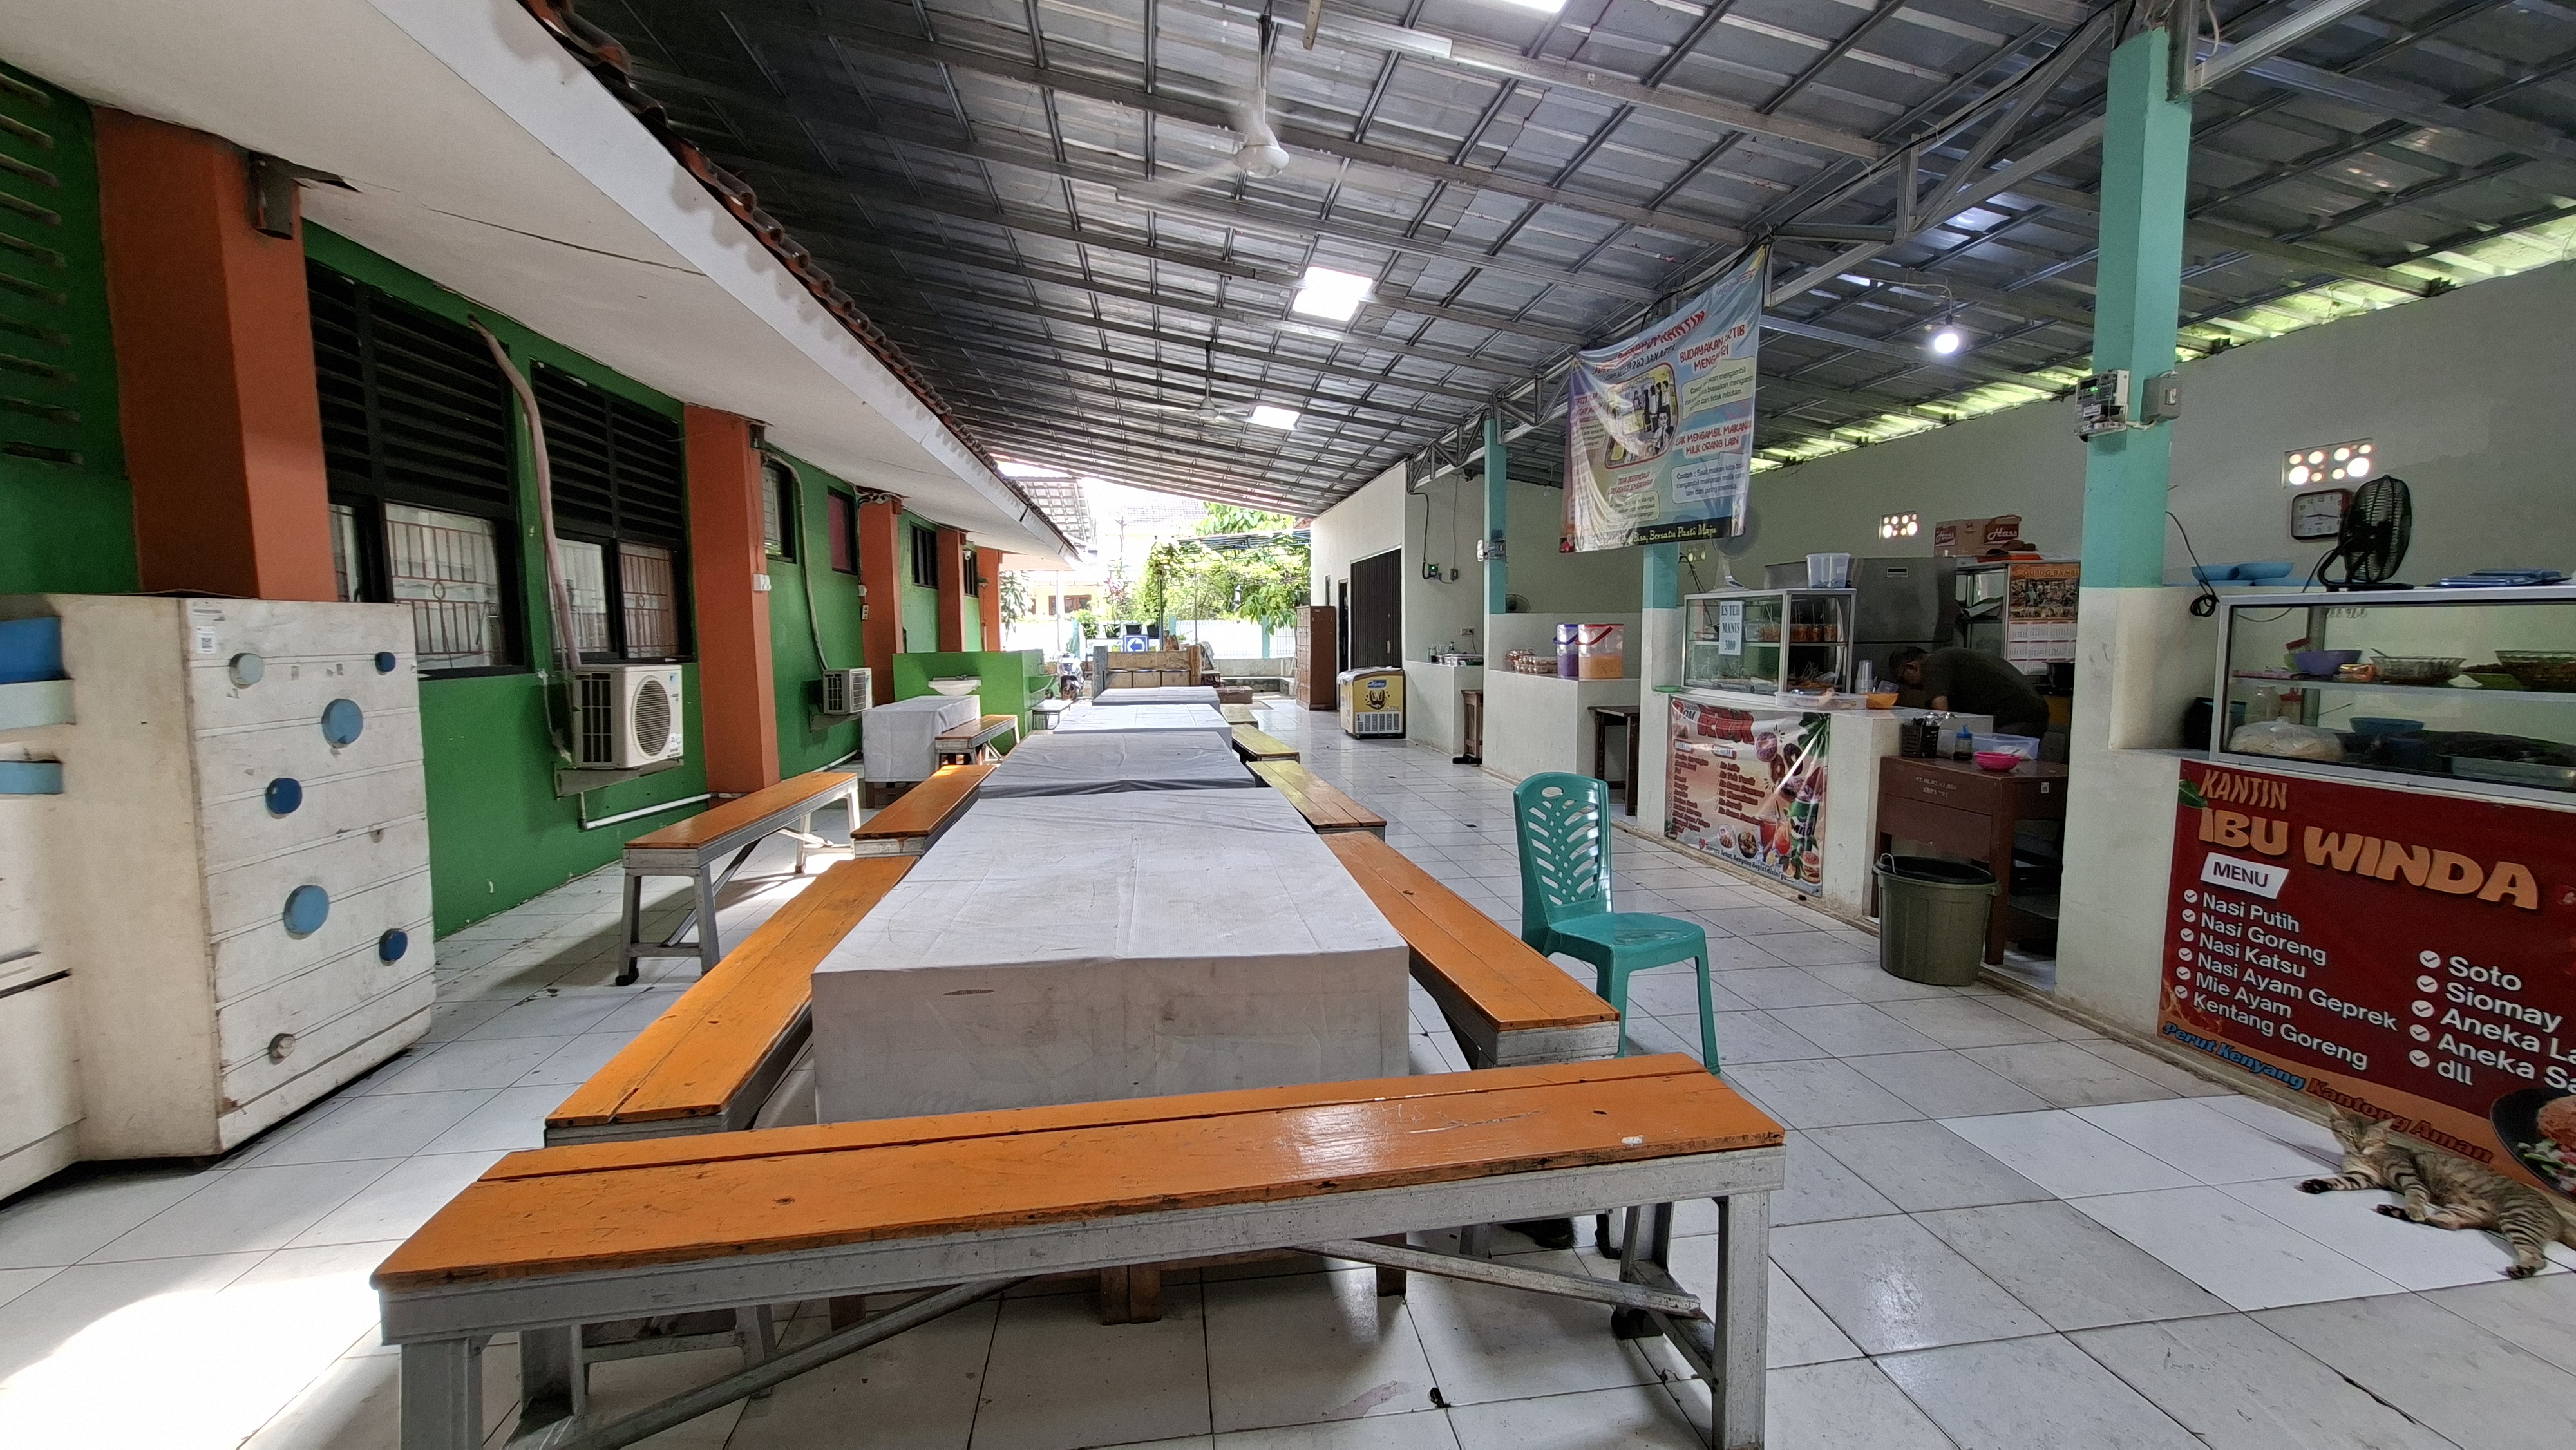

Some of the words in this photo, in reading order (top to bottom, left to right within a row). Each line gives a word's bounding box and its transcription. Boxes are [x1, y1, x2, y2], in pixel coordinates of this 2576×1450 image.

[1660, 310, 1705, 343] KANTIN
[1680, 336, 1724, 362] BUDAYAKAN
[1701, 438, 1723, 451] ORANG
[1725, 435, 1739, 447] LAIN
[1649, 529, 1676, 541] Bersatu
[1677, 526, 1696, 538] Pasti
[1697, 523, 1717, 537] Maju
[1987, 527, 2018, 540] Hass
[1721, 605, 1728, 616] ES
[1728, 605, 1740, 616] TEH
[1721, 622, 1740, 634] MANIS
[2199, 769, 2287, 811] KANTIN
[2198, 807, 2289, 856] IBU
[2303, 825, 2539, 910] WINDA
[2213, 861, 2269, 888] MENU
[2202, 892, 2246, 918] Nasi
[2249, 904, 2300, 933] Putih
[2199, 932, 2240, 958] Nasi
[2244, 945, 2306, 978] Katsu
[2201, 912, 2242, 937] Nasi
[2248, 926, 2327, 966] Goreng
[2197, 952, 2238, 979] Nasi
[2242, 968, 2302, 999] Ayam
[2308, 988, 2398, 1031] Geprek
[2448, 956, 2522, 991] Soto
[2195, 972, 2230, 996] Mie
[2233, 986, 2292, 1019] Ayam
[2445, 981, 2563, 1033] Siomay
[2193, 992, 2274, 1037] Kentang
[2280, 1022, 2369, 1071] Goreng
[2439, 1007, 2541, 1053] Aneka
[2436, 1032, 2535, 1080] Aneka
[2436, 1059, 2474, 1086] dll
[2163, 1020, 2218, 1053] Perut
[2216, 1042, 2307, 1091] Kenyang
[2306, 1077, 2412, 1132] Kantong
[2409, 1119, 2494, 1164] Aman
